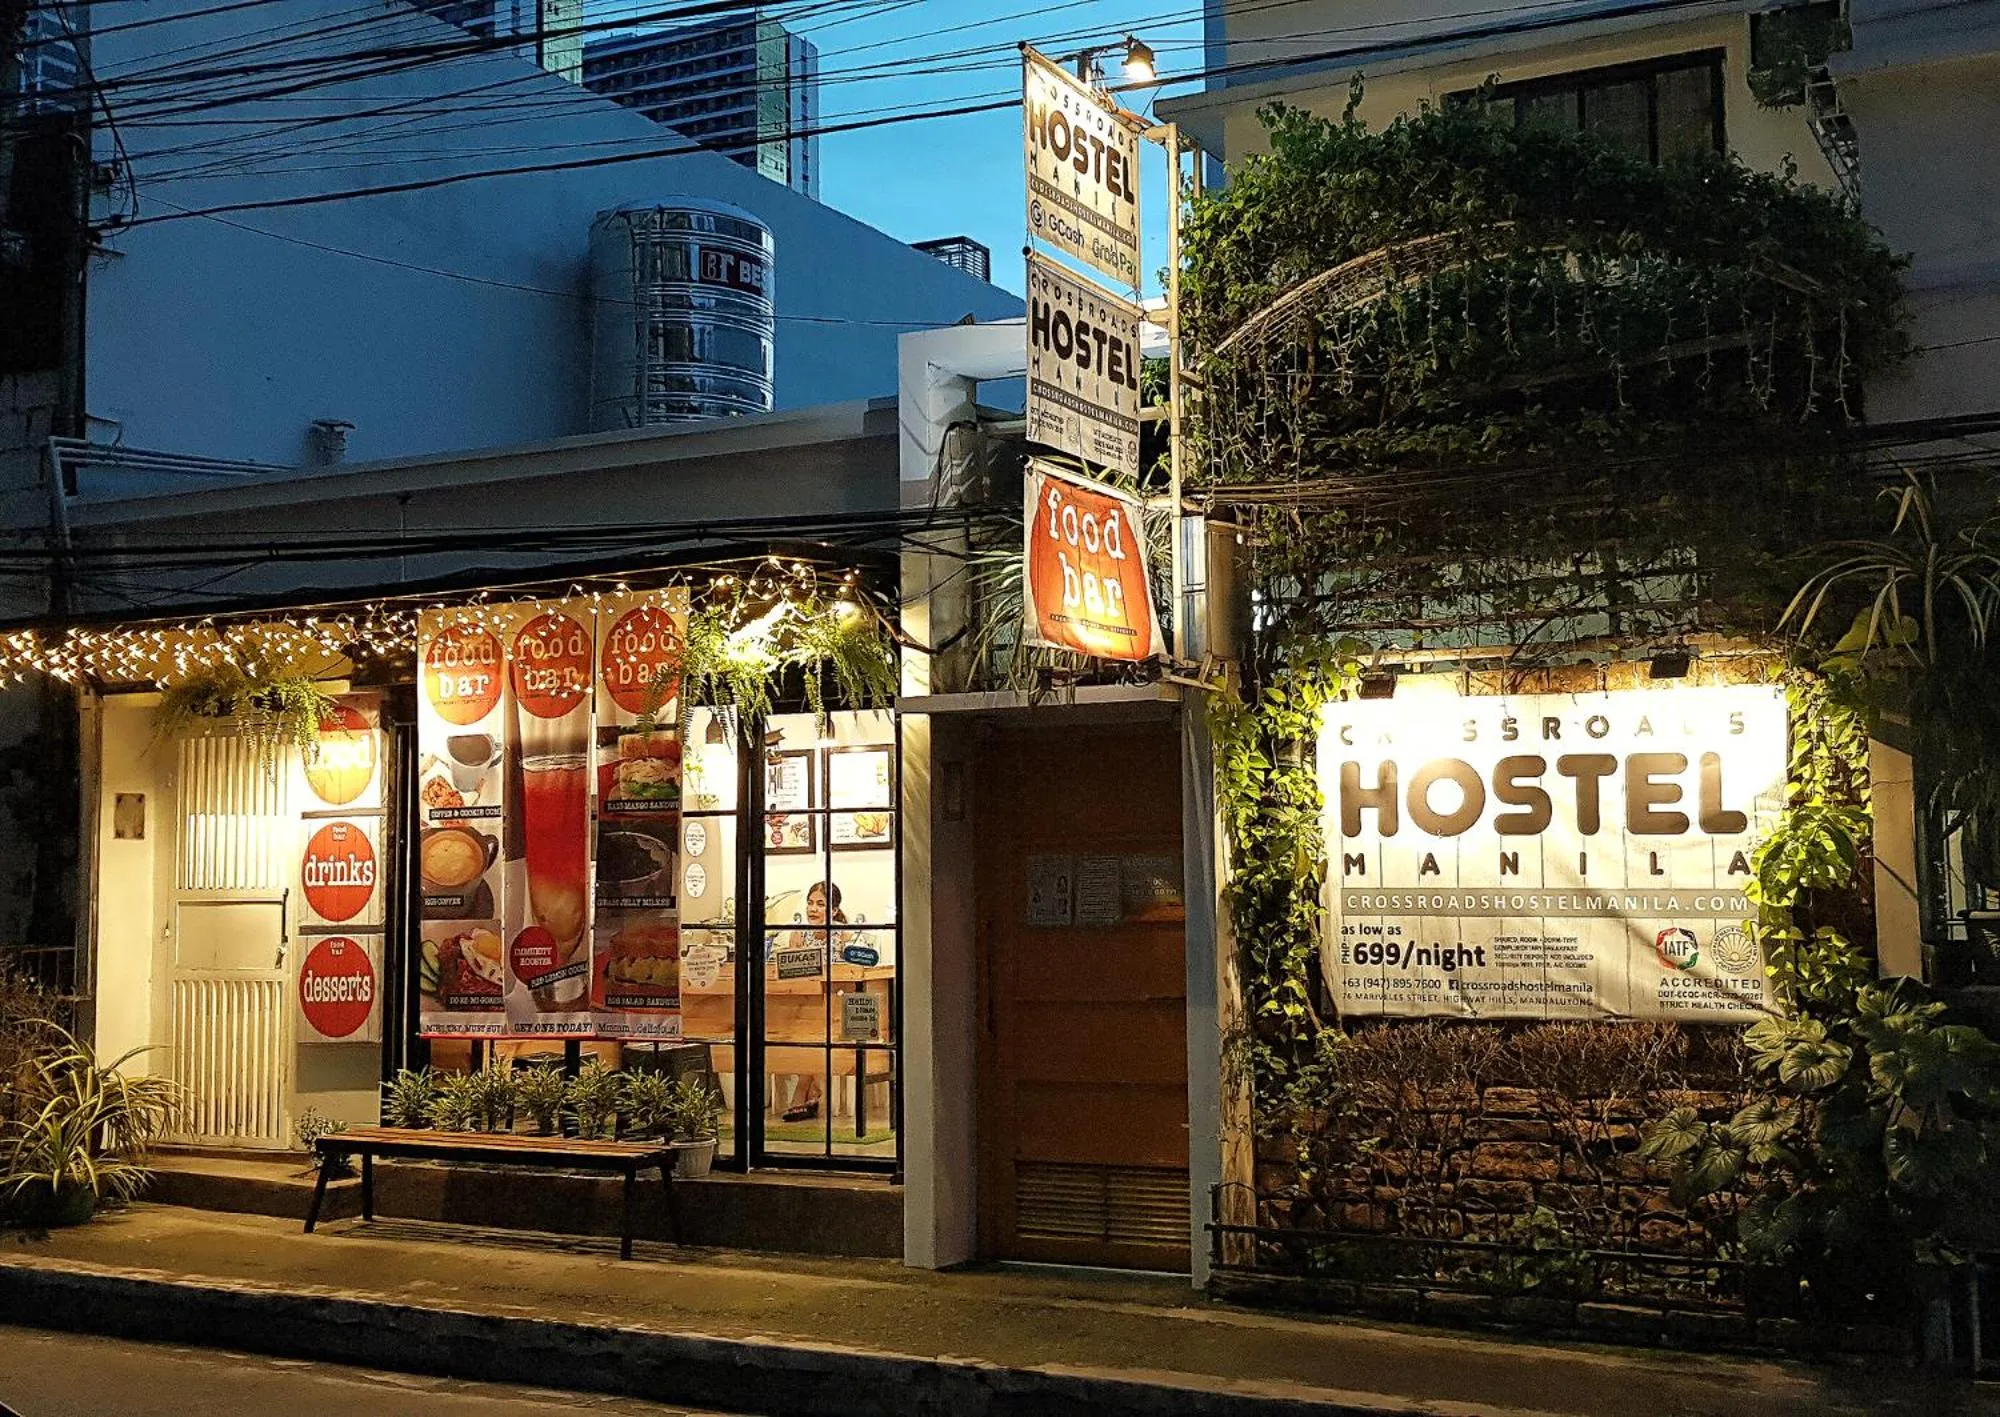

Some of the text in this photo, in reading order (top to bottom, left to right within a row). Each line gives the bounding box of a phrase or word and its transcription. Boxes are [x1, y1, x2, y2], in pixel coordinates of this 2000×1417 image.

[1029, 101, 1135, 205] HOSTEL
[1048, 213, 1085, 249] GCash
[1032, 273, 1138, 338] CROSSROADS
[1031, 297, 1138, 392] HOSTEL
[1046, 486, 1126, 561] food
[1057, 550, 1123, 618] bar
[518, 630, 585, 661] food
[611, 624, 677, 655] food
[431, 640, 496, 669] food
[437, 672, 490, 699] bar
[524, 666, 578, 691] bar
[1340, 751, 1749, 838] HOSTEL
[304, 854, 374, 887] drinks
[1343, 850, 1751, 877] MANILA
[1347, 895, 1749, 911] CROSSROADSHOSTELMANILA.COM
[1341, 923, 1402, 936] as low as
[780, 953, 816, 964] BUKAS
[1353, 940, 1486, 972] 699/night
[1663, 940, 1690, 957] IATF
[303, 970, 372, 1004] desserts
[1392, 978, 1413, 989] 895
[1460, 980, 1593, 993] crossroadshostelmanila
[1660, 977, 1761, 990] ACCREDITED
[1660, 1001, 1689, 1009] STRICT
[1691, 1001, 1725, 1010] HEALTH
[514, 1023, 593, 1033] GET ONE TODAY!
